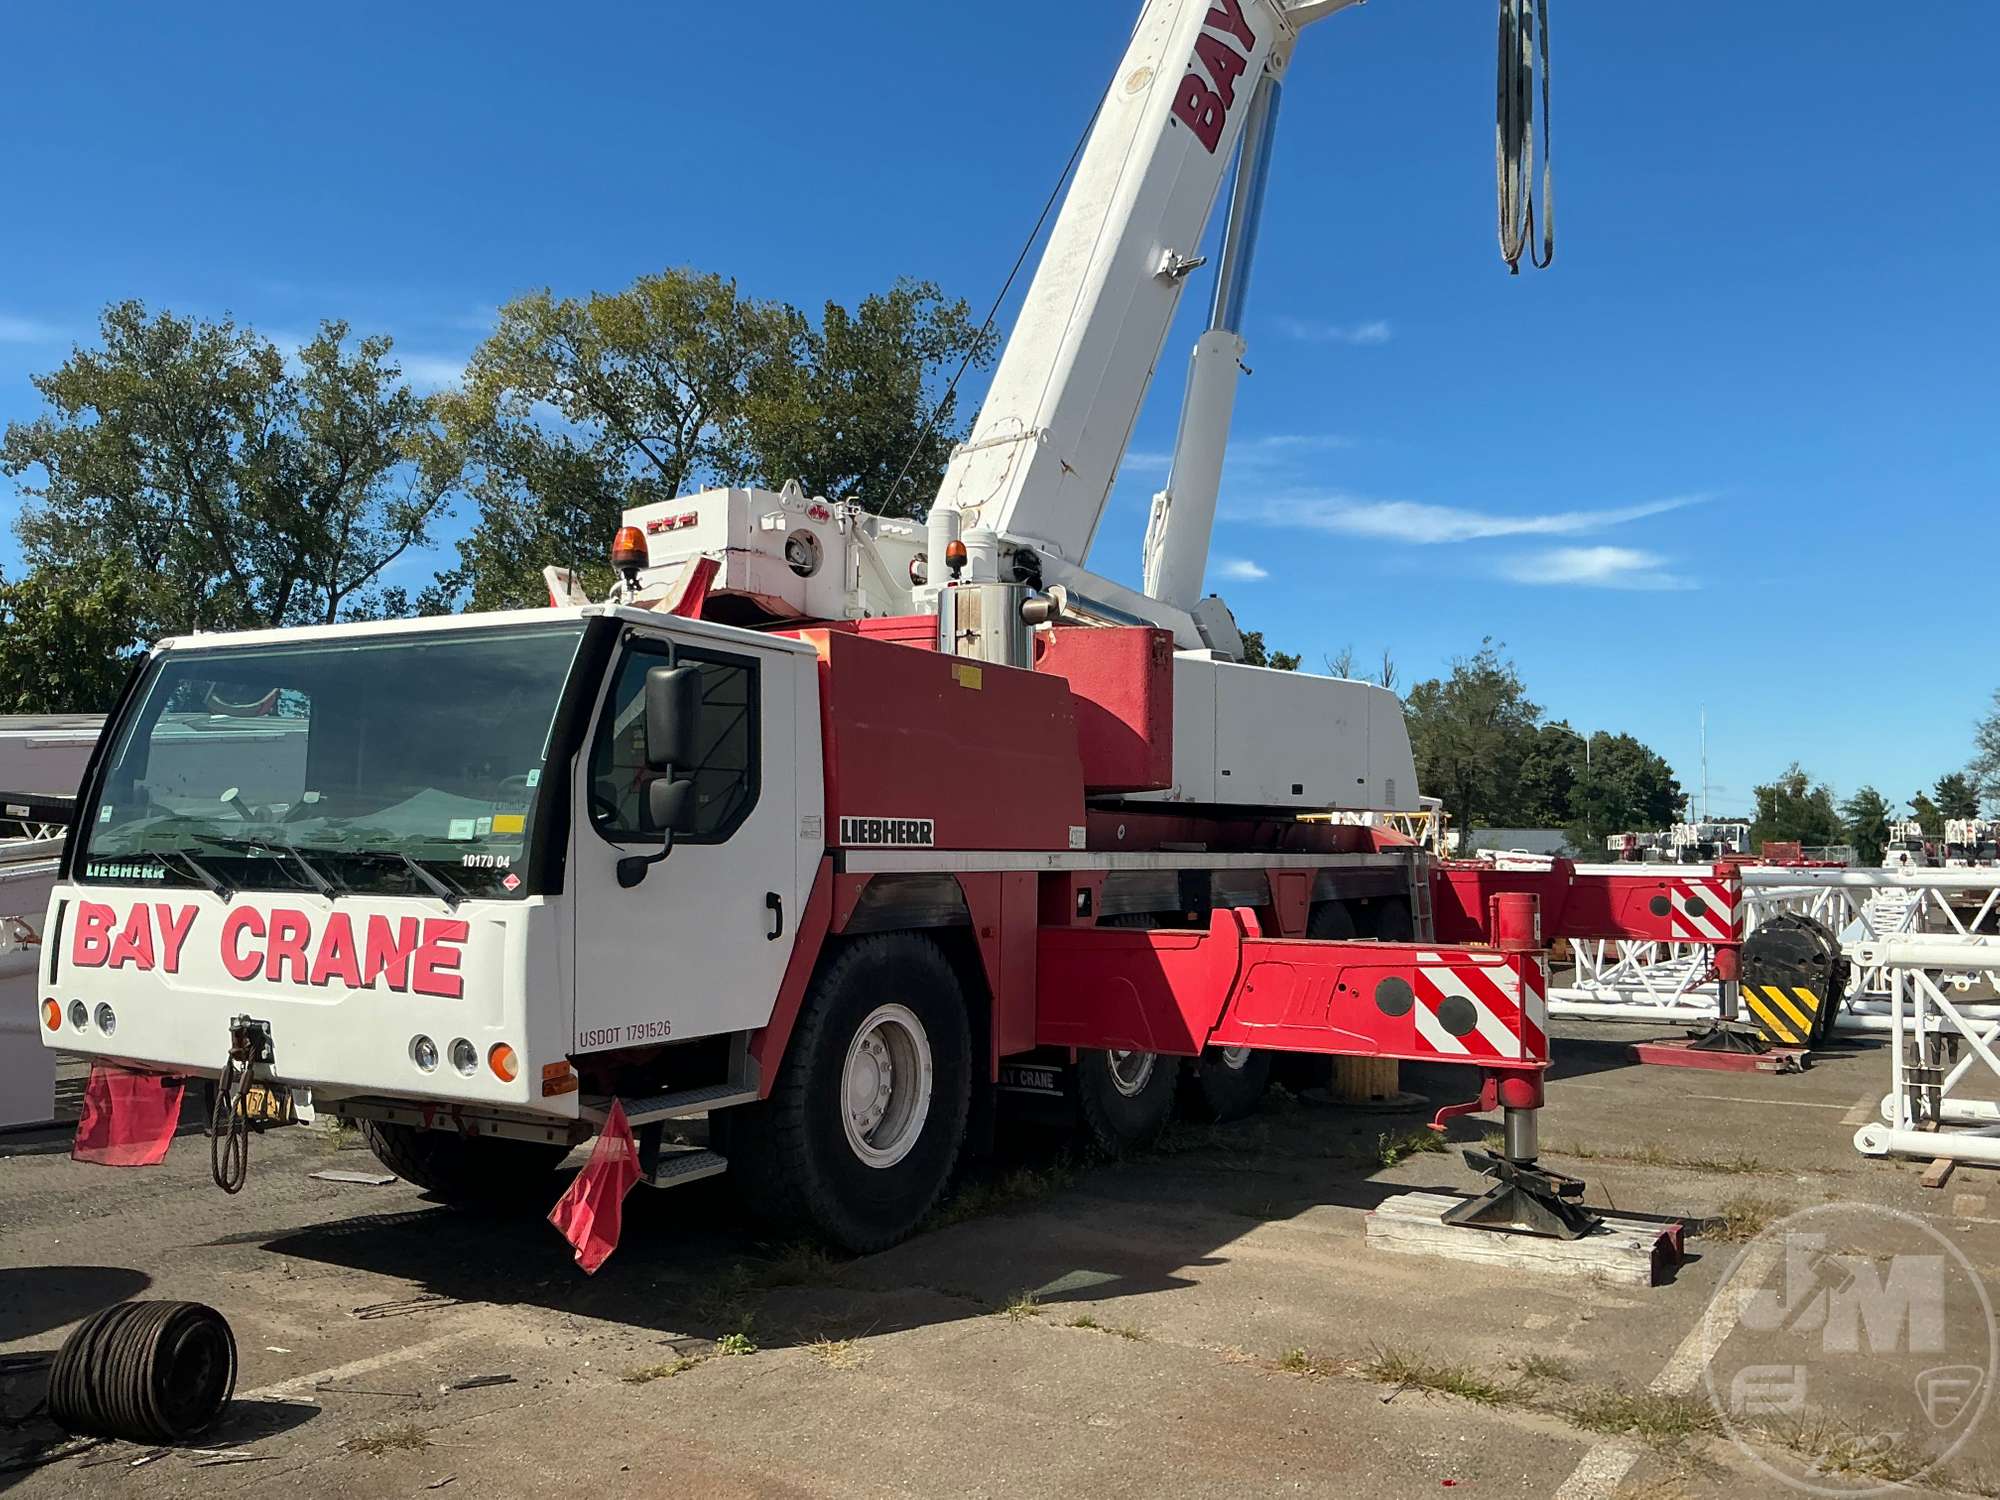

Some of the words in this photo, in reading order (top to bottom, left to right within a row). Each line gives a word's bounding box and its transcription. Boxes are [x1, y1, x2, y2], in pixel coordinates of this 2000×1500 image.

[1171, 0, 1256, 154] BAY
[842, 819, 933, 844] LIEBHERR
[86, 863, 166, 879] LIEBHERR
[462, 854, 494, 867] 10170
[497, 855, 511, 868] 04
[72, 901, 199, 974] BAY
[221, 905, 469, 999] CRANE
[580, 1027, 621, 1047] USDOT
[626, 1020, 671, 1040] 1791526
[1019, 1070, 1055, 1089] CRANE
